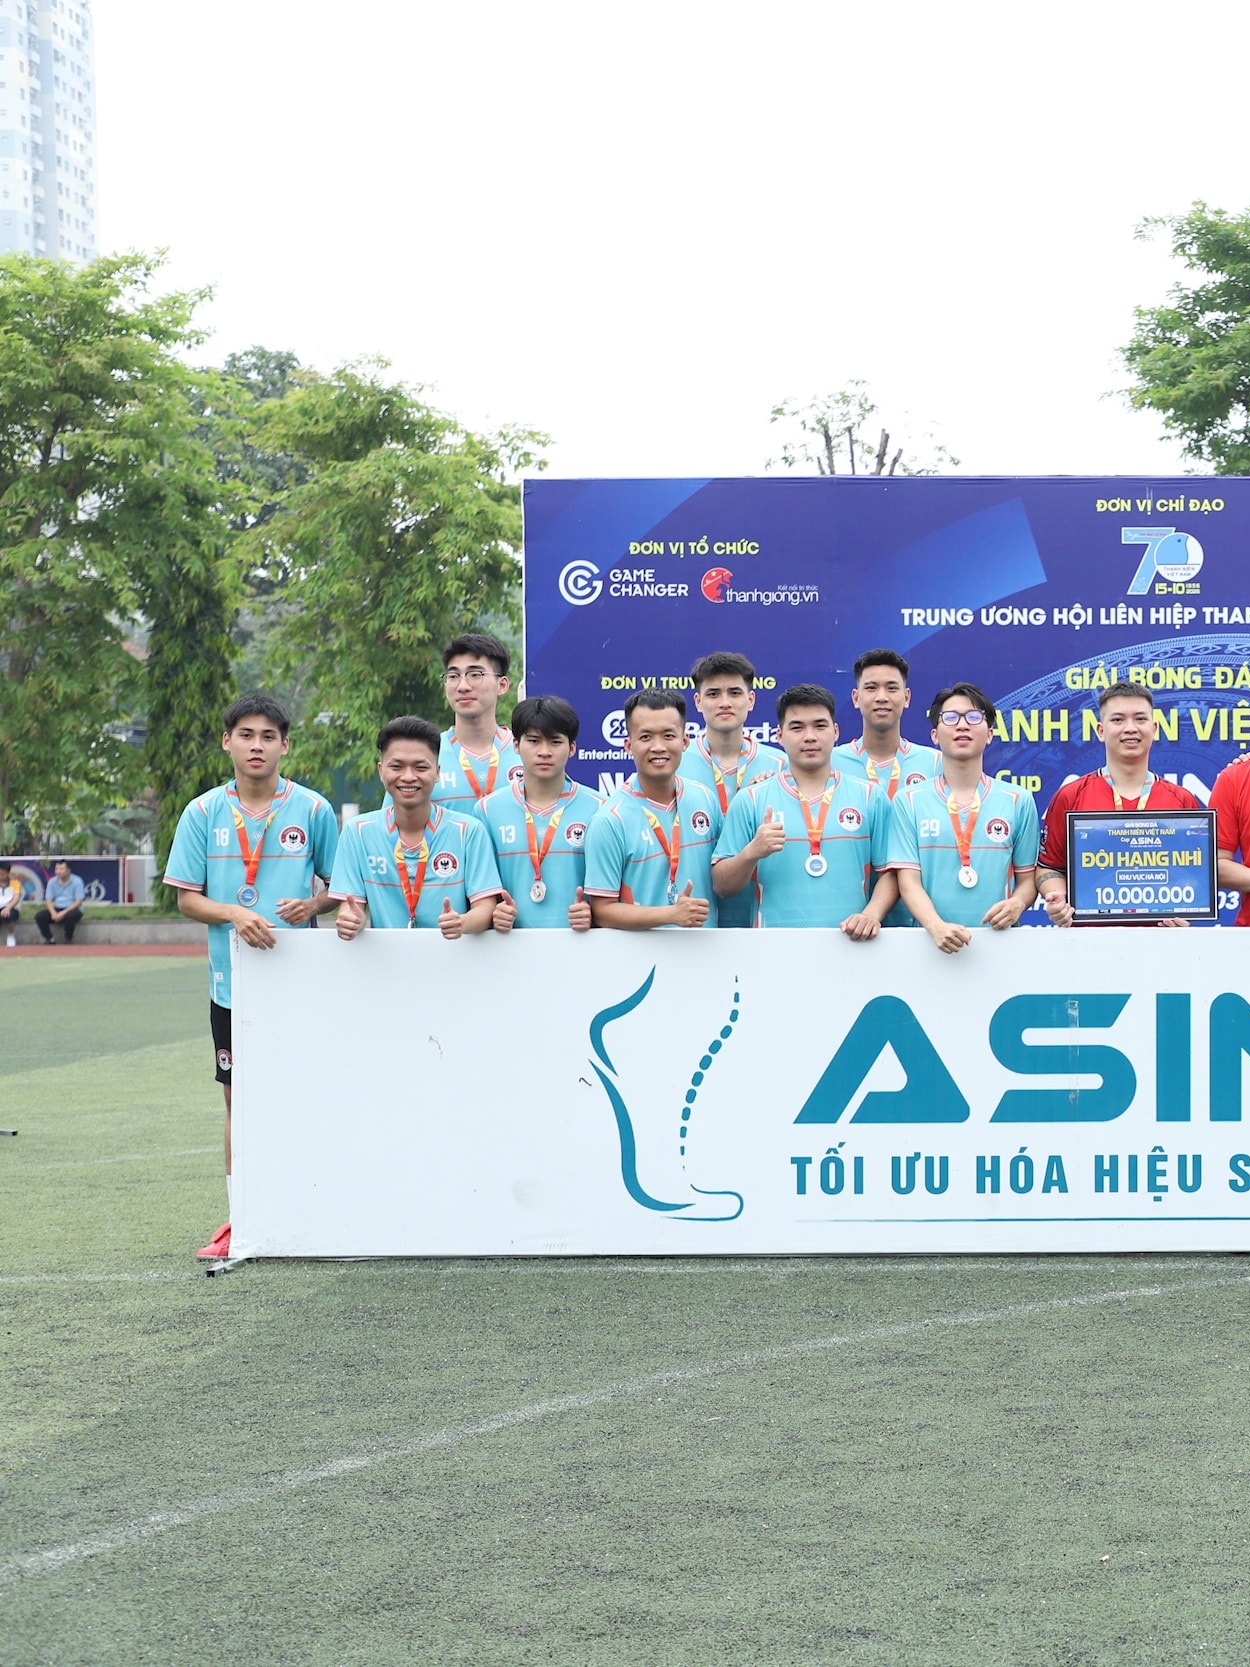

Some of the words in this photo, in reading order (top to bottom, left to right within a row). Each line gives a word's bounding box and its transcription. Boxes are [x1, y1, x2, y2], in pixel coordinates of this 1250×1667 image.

[1096, 497, 1131, 512] ĐƠN
[1136, 499, 1152, 515] VỊ
[1156, 495, 1184, 512] CHỈ
[1189, 499, 1225, 515] ĐẠO
[629, 541, 664, 555] ĐƠN
[669, 542, 684, 558] VỊ
[689, 536, 709, 555] TỔ
[713, 541, 760, 555] CHỨC
[609, 569, 655, 583] GAME
[609, 583, 689, 597] CHANGER
[1155, 583, 1185, 595] 15-10
[901, 608, 974, 626] TRUNG
[981, 605, 1047, 626] ƯƠNG
[1053, 603, 1092, 630] HỘI
[1100, 602, 1143, 625] LIÊN
[1150, 602, 1197, 629] HIỆP
[601, 675, 636, 690] ĐƠN
[1065, 660, 1118, 690] GIẢI
[1129, 661, 1202, 689] BÓNG
[1082, 708, 1178, 742] NN
[440, 771, 457, 789] 14
[996, 769, 1042, 792] Cup
[213, 828, 229, 847] 18
[499, 825, 516, 844] 13
[919, 819, 940, 837] 29
[1130, 837, 1162, 845] ASINA
[1081, 849, 1114, 870] ĐỘI
[1117, 851, 1169, 869] HẠNG
[1172, 847, 1202, 866] NHÌ
[1095, 886, 1195, 905] 10.000.000
[790, 1142, 864, 1195] TỐI
[891, 1152, 950, 1195] ƯU
[976, 1147, 1069, 1195] HÓA
[1094, 1145, 1202, 1202] HIỆU
